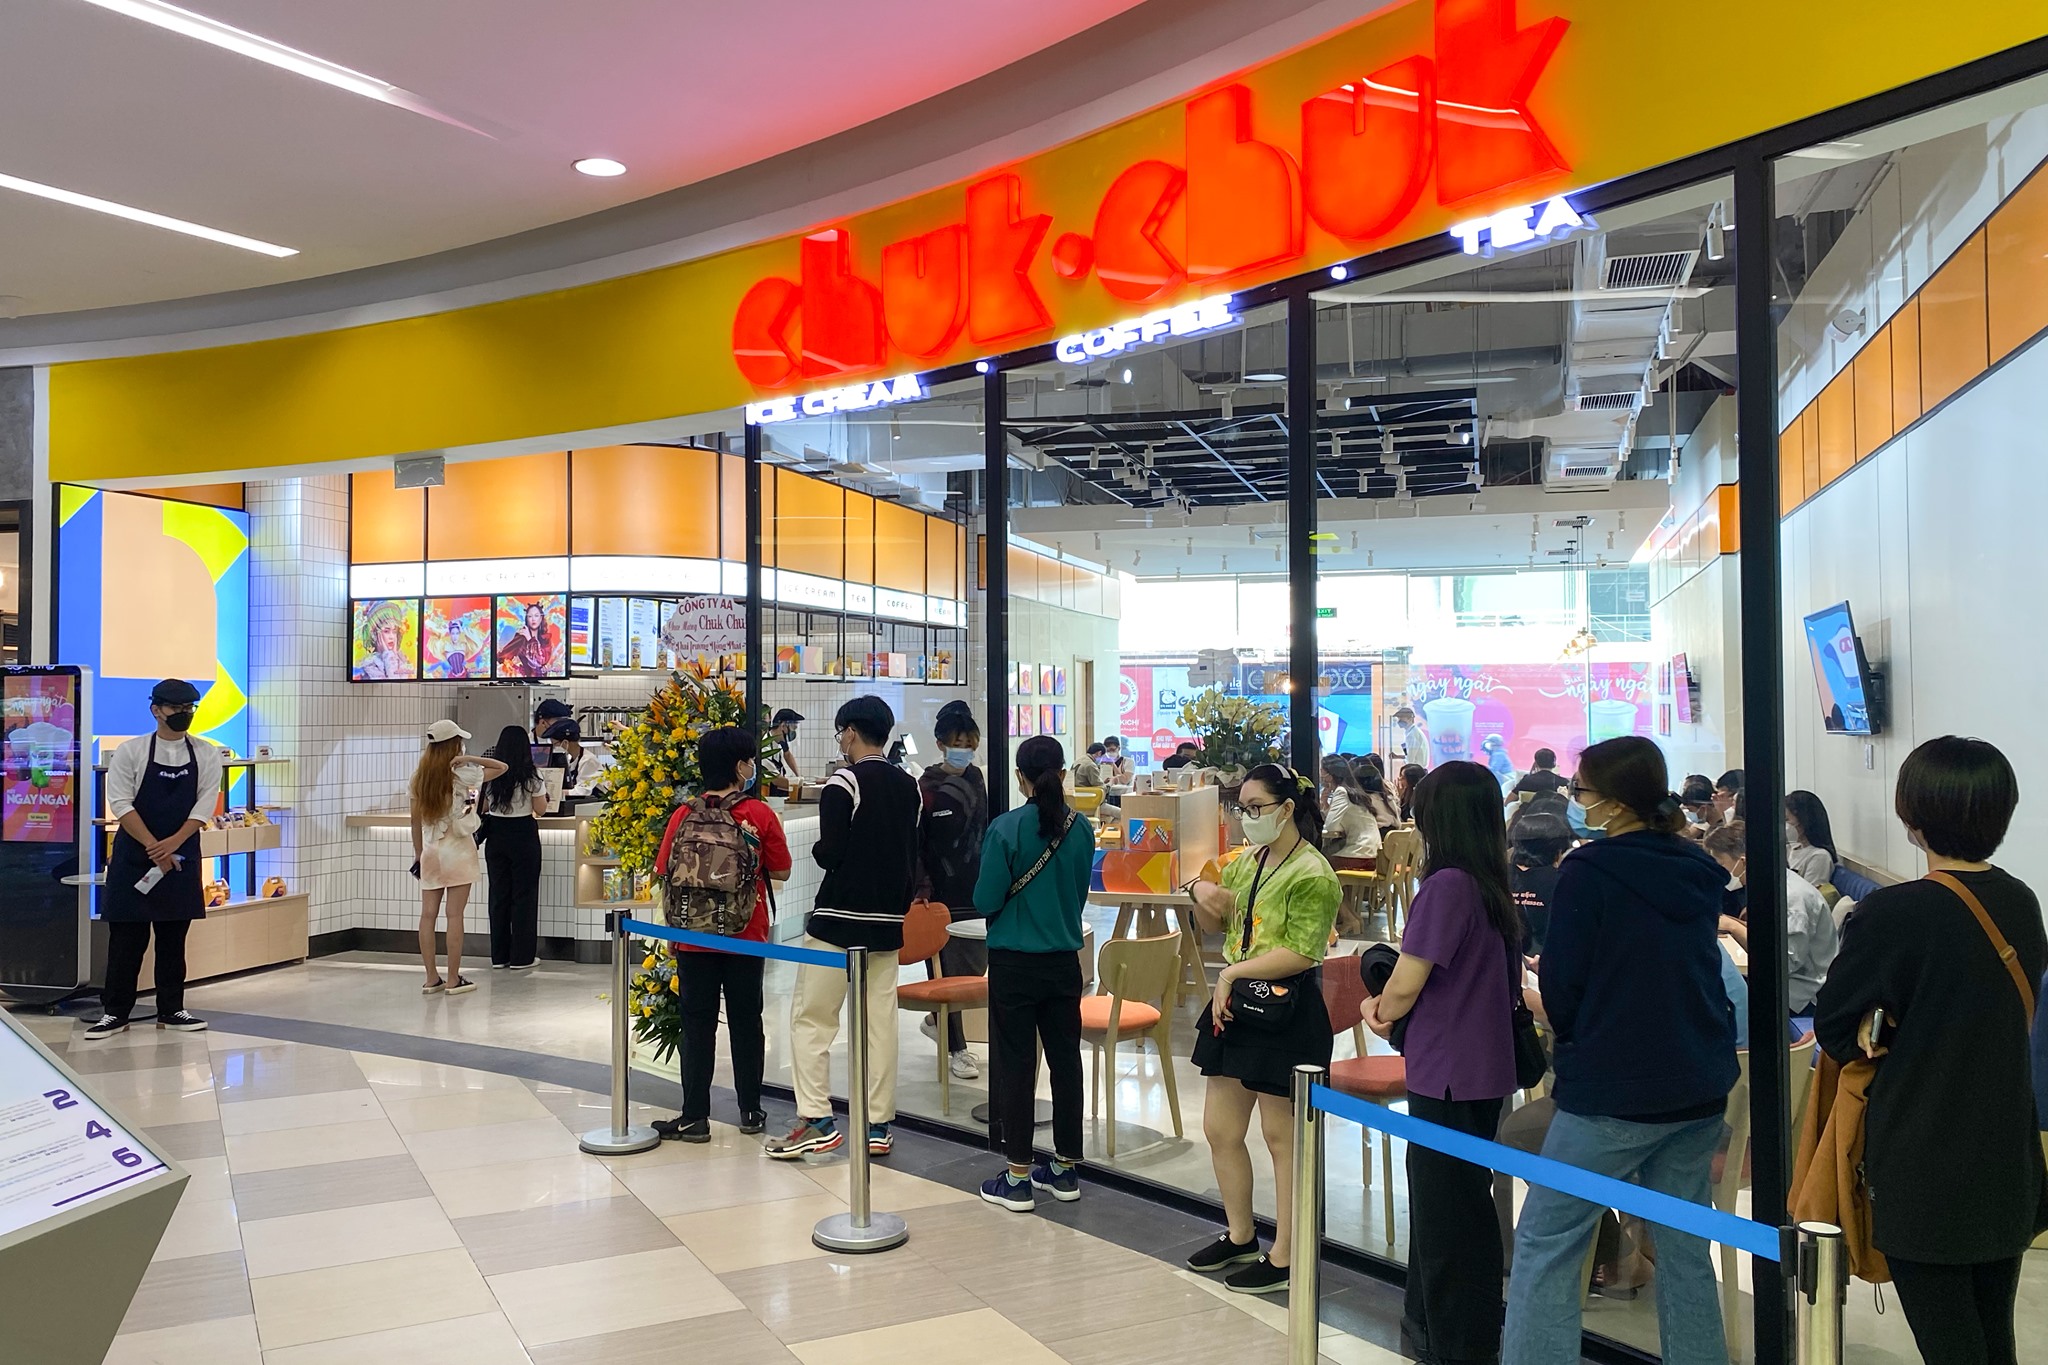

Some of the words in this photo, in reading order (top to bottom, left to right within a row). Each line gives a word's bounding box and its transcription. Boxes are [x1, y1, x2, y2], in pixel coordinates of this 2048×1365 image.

[745, 396, 798, 426] ICE
[801, 373, 923, 416] CREAM
[1056, 294, 1234, 364] COFFEE
[1450, 195, 1585, 256] TEA
[707, 598, 719, 609] TY
[720, 599, 733, 611] AA
[851, 593, 867, 603] TEA
[699, 614, 724, 630] Chuk
[43, 1089, 79, 1110] 2
[86, 1120, 112, 1139] 4
[112, 1147, 142, 1168] 6
